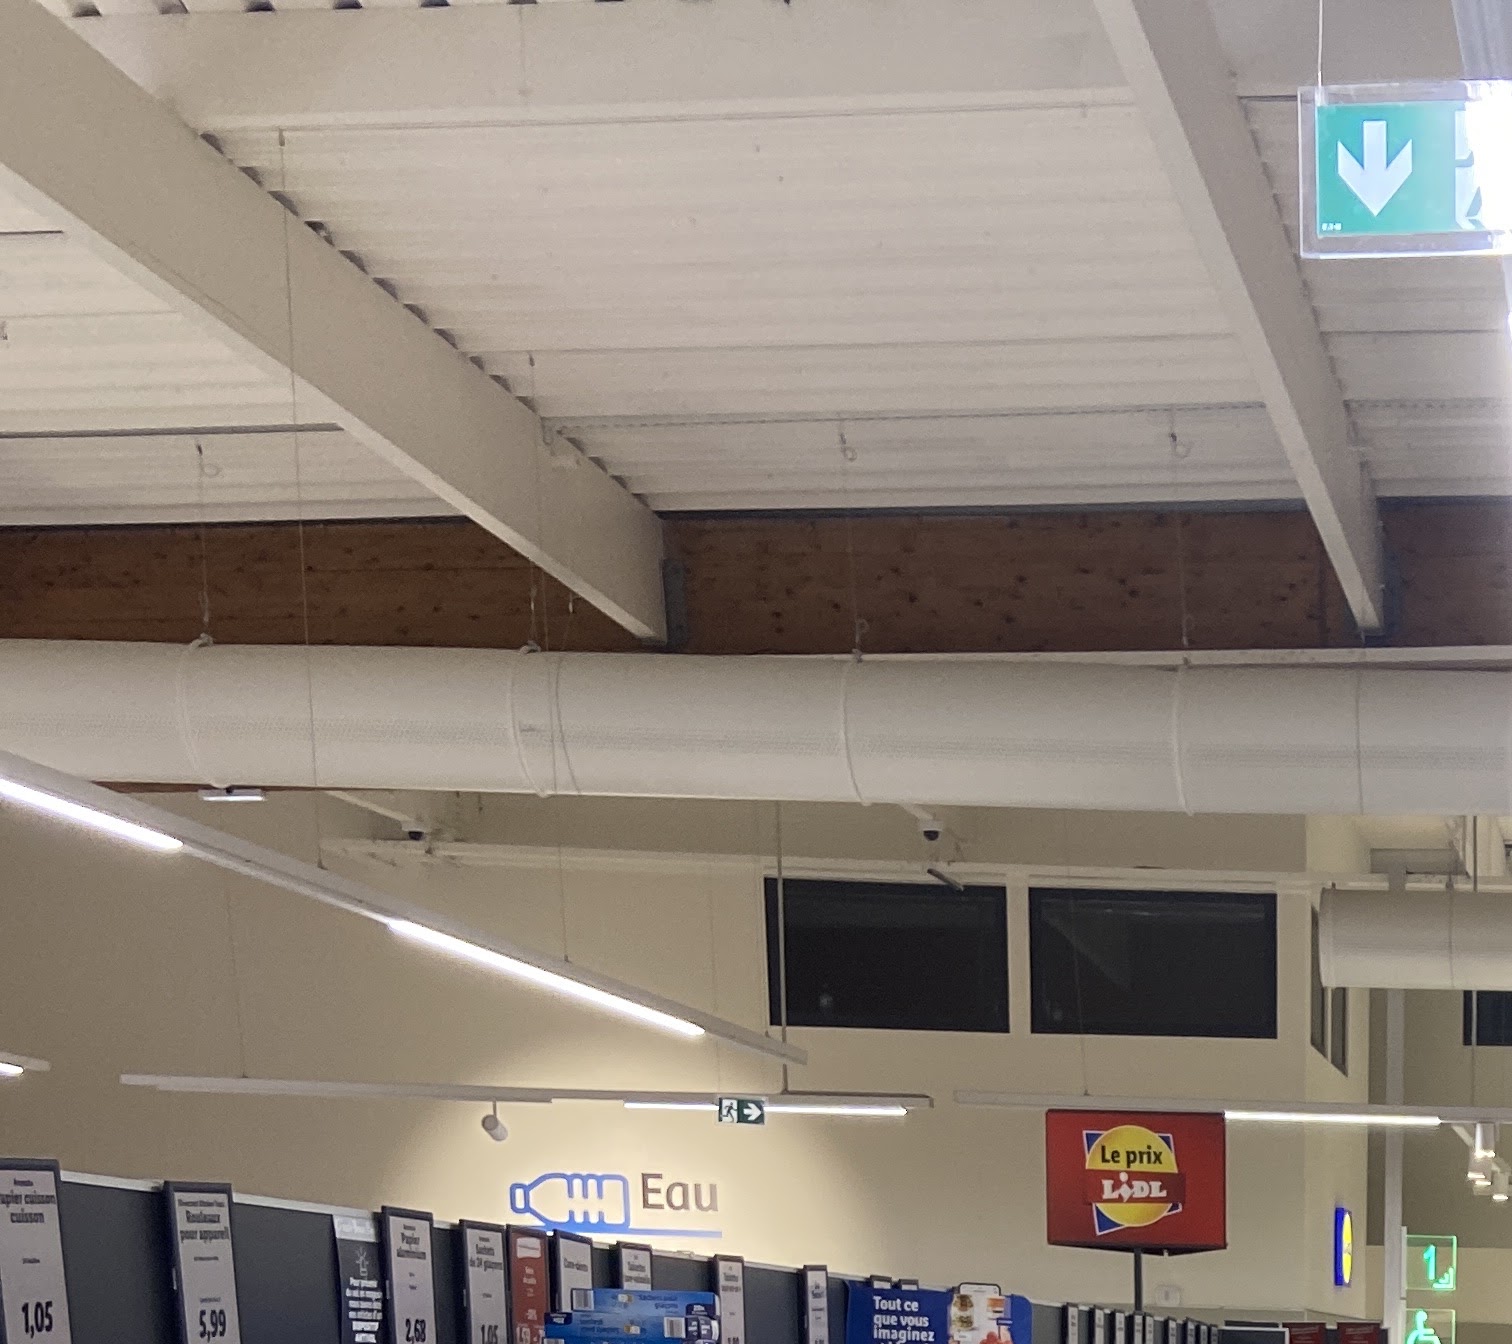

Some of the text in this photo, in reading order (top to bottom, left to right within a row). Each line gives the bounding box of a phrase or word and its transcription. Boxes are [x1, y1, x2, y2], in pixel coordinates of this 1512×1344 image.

[1101, 1145, 1163, 1168] Le prix
[641, 1172, 719, 1212] Eau
[10, 1208, 45, 1223] cuisson
[1423, 1244, 1436, 1281] 1
[873, 1296, 919, 1312] Tout ce
[22, 1301, 53, 1338] 1,05
[199, 1309, 227, 1343] 5,99
[873, 1315, 929, 1328] que vous
[873, 1327, 935, 1344] imaginez
